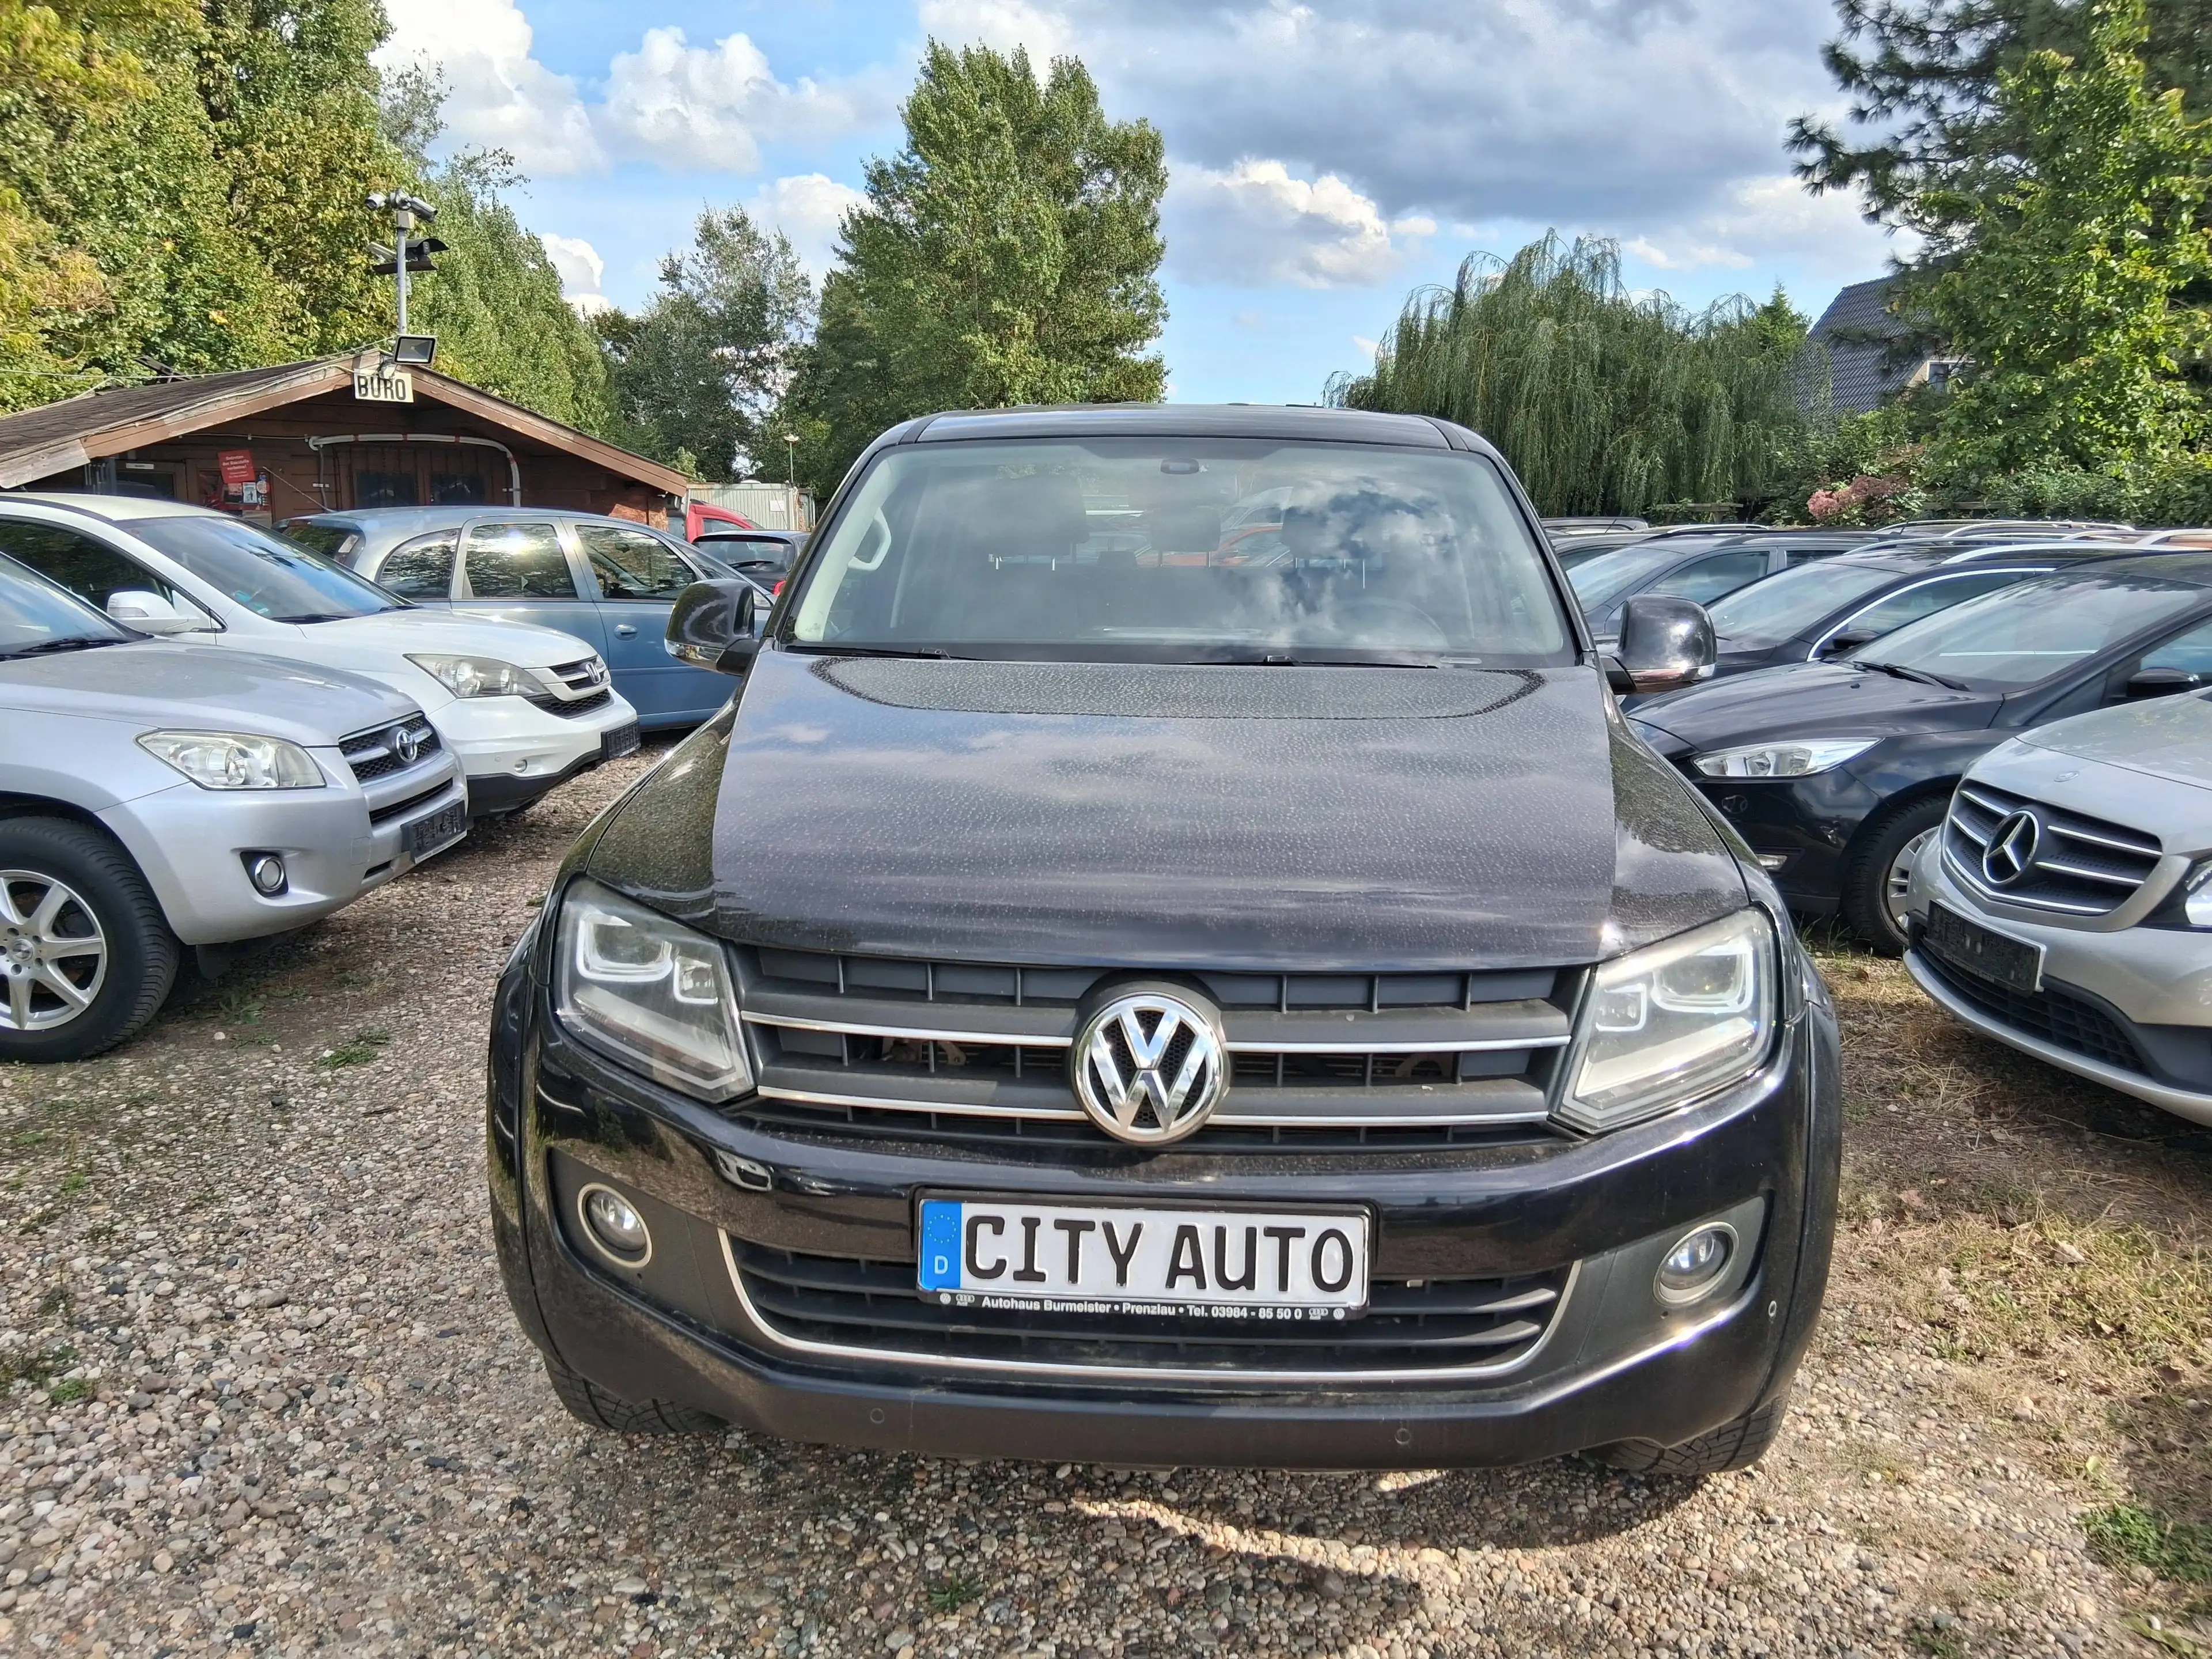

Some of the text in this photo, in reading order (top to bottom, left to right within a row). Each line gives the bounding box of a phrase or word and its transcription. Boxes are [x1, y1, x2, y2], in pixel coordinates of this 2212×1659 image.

[934, 1255, 948, 1274] D
[966, 1215, 1353, 1292] CITY AUTO
[982, 1296, 1040, 1310] Autohaus
[1043, 1300, 1112, 1313] Burmeister
[1122, 1302, 1176, 1316] Prenzlau
[1186, 1304, 1209, 1317] Tel.
[1211, 1306, 1248, 1319] 03984
